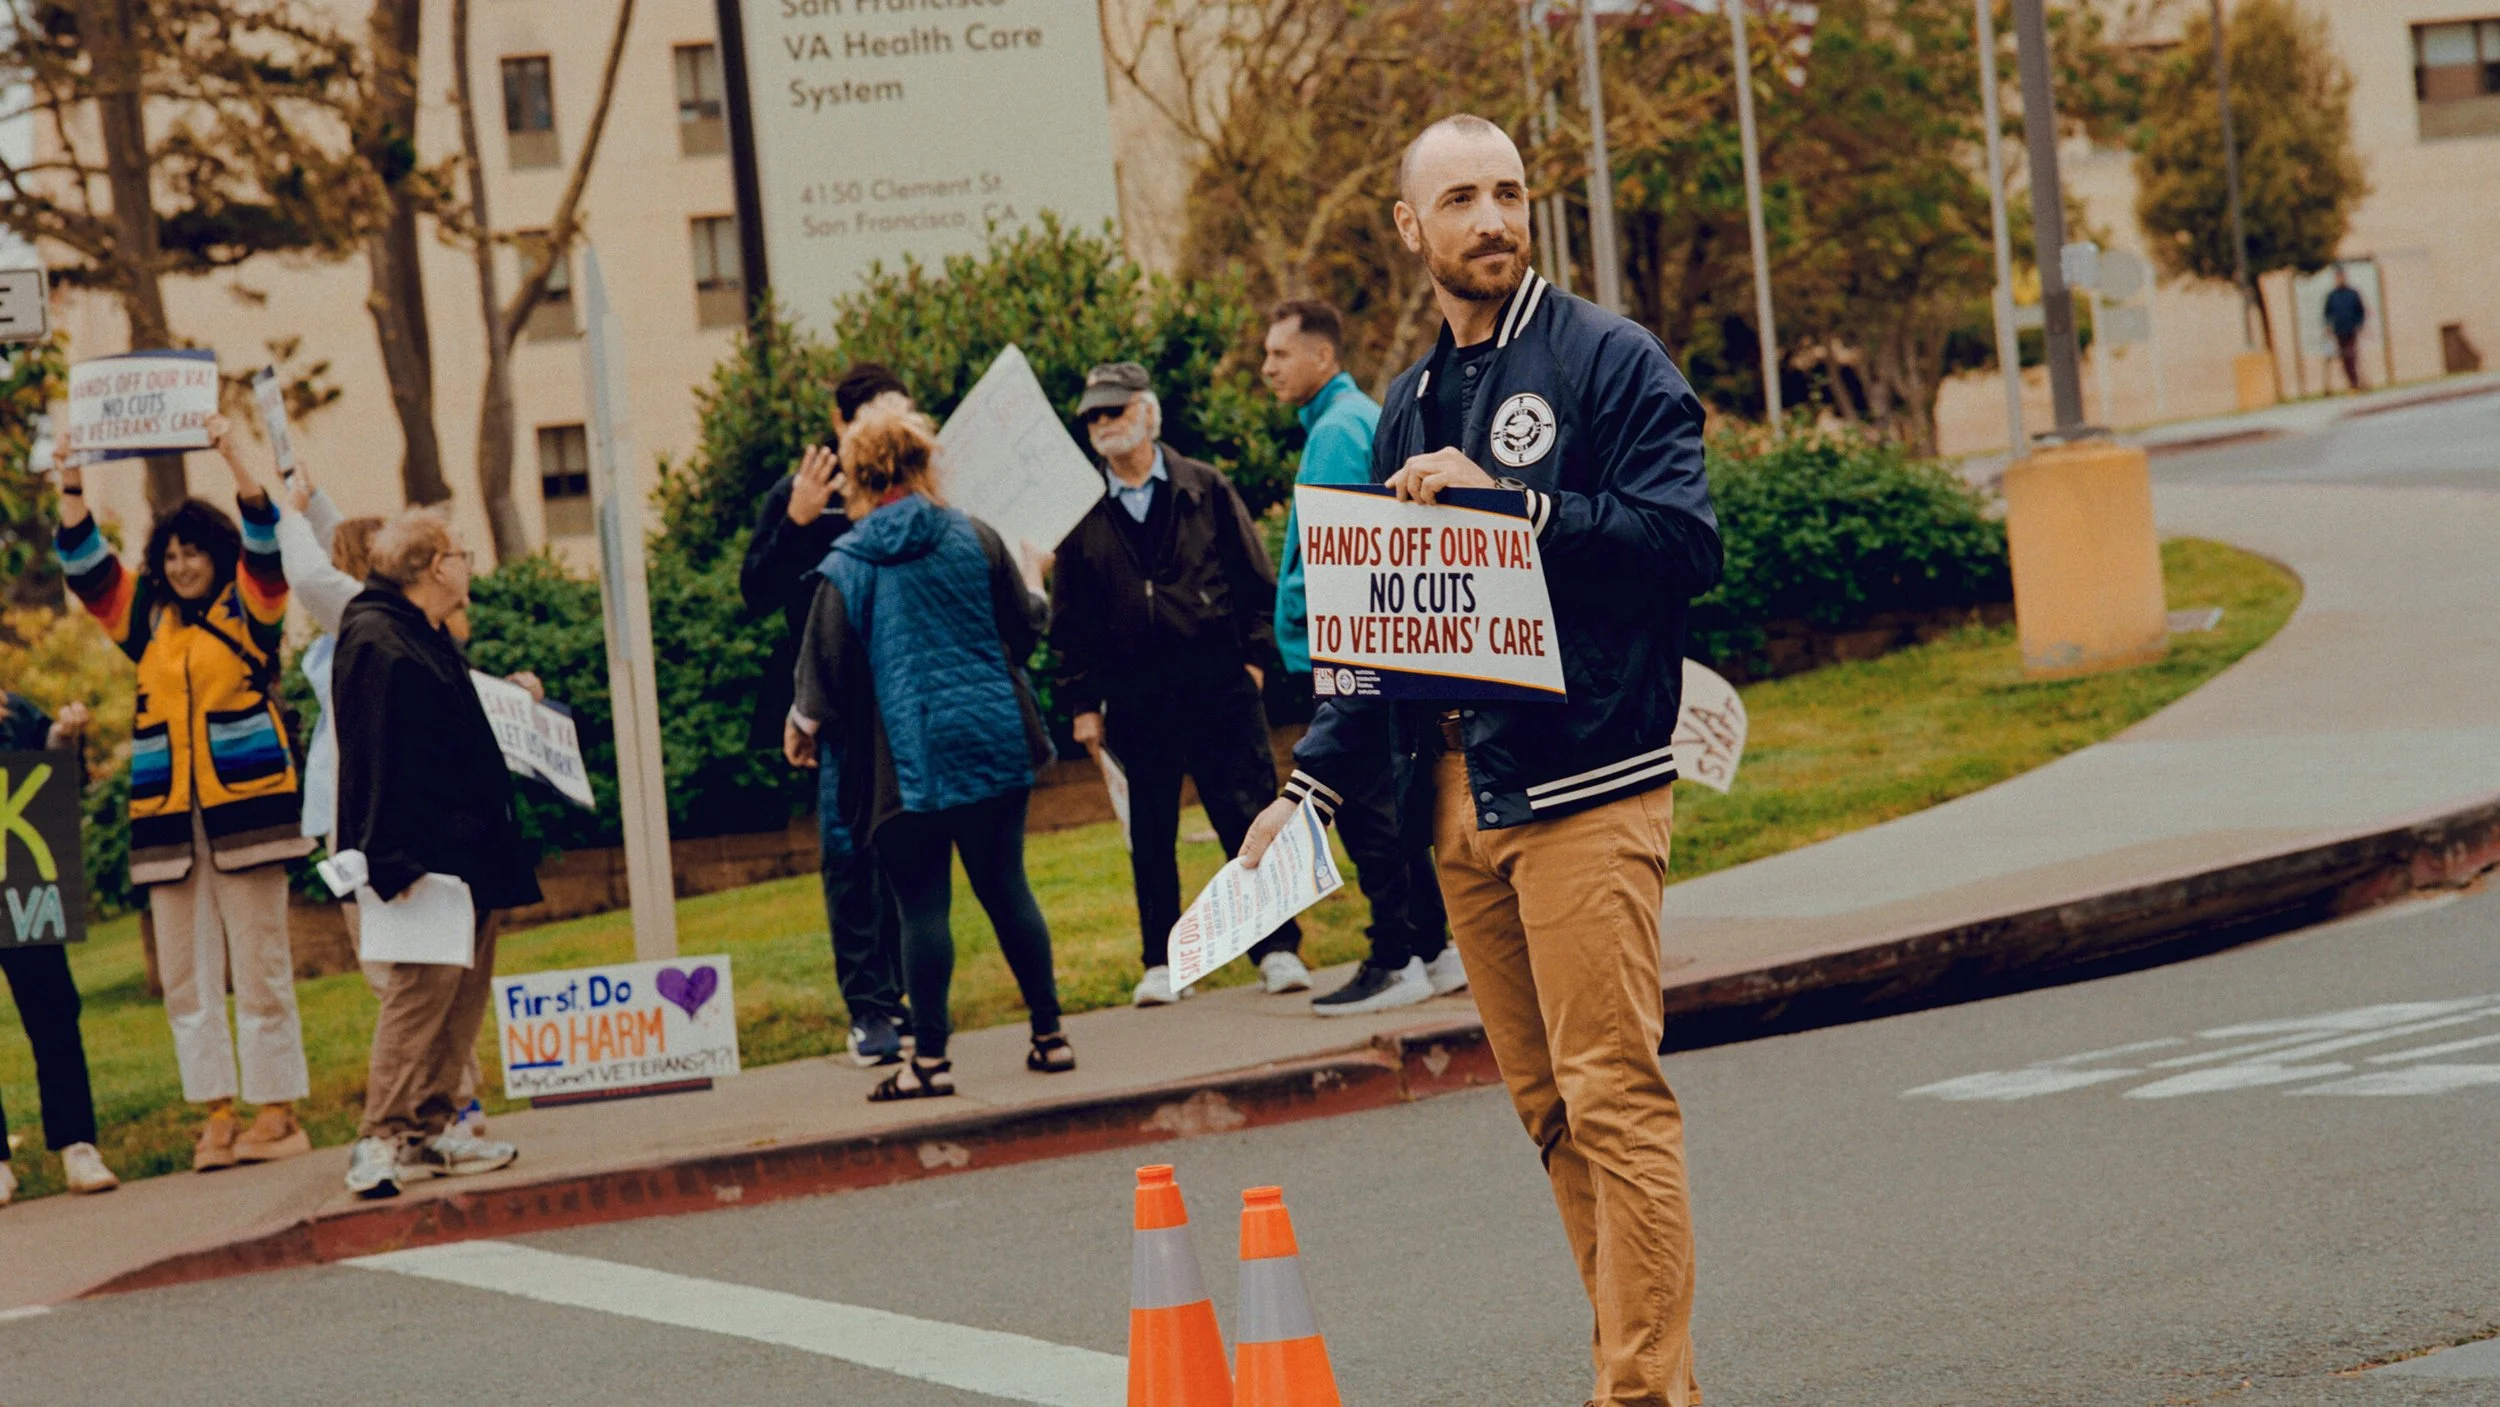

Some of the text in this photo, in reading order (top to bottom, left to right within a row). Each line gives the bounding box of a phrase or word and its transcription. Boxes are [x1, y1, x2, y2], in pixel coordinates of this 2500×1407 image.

[781, 0, 840, 18] San
[783, 21, 1042, 61] VA Health Care
[788, 78, 904, 112] System
[801, 179, 863, 204] 4150
[870, 177, 971, 201] Clement
[801, 213, 848, 237] San
[982, 200, 1018, 222] CA
[102, 391, 166, 419] NO CUTS
[1306, 526, 1533, 570] HANDS OFF OUR VA!
[1369, 572, 1477, 614] NO CUTS
[1315, 615, 1546, 657] TO VETERANS' CARE
[5, 883, 67, 943] VA
[588, 974, 632, 1008] Do
[506, 1005, 667, 1065] NO HARM
